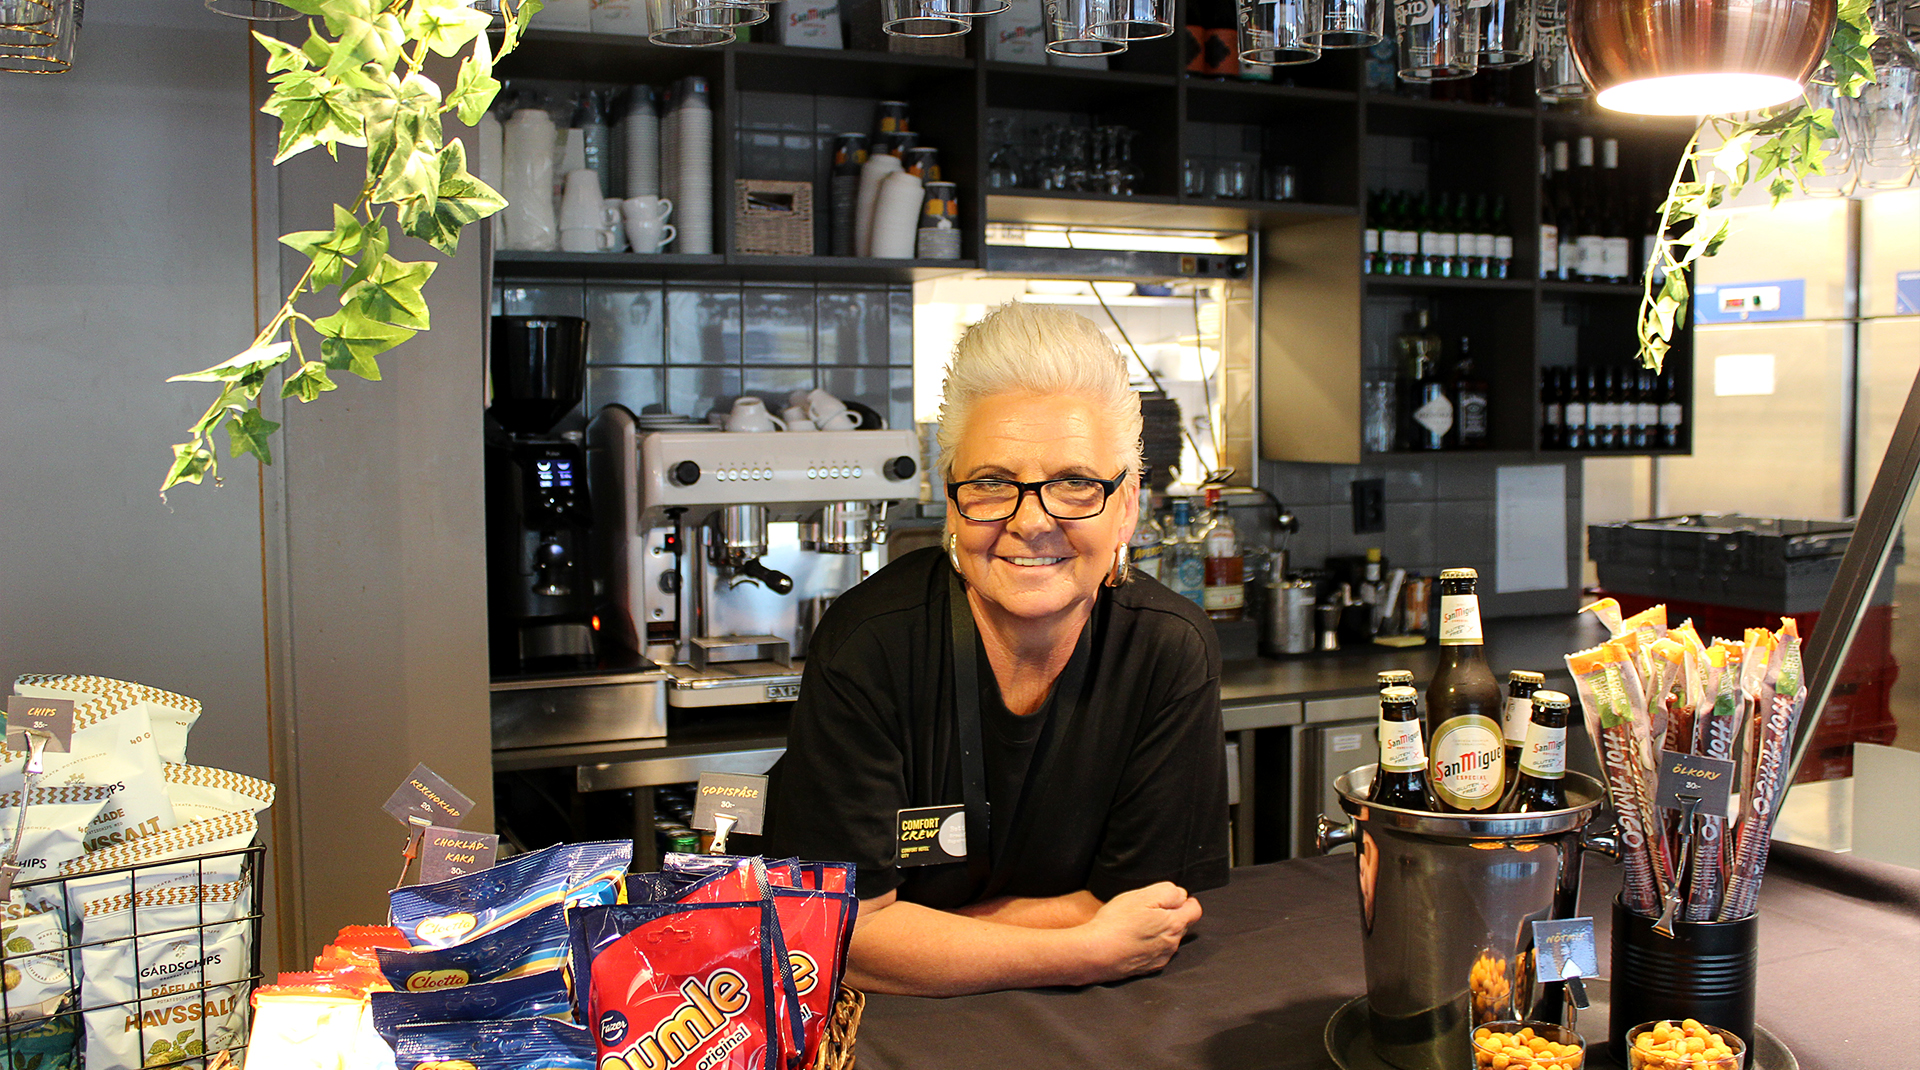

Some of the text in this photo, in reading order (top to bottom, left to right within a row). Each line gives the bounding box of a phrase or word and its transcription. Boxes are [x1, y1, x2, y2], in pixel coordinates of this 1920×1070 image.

[27, 707, 57, 717] CHIPS
[701, 785, 759, 799] GODISPÅSE
[1456, 782, 1479, 792] GLUTEN
[409, 778, 461, 817] KEXCHOKLAD
[1609, 775, 1645, 848] AMIGO
[901, 817, 940, 831] COMFORT
[82, 815, 161, 854] VSSALT
[901, 829, 940, 841] CREW
[433, 837, 490, 851] CHOKLAD-
[445, 852, 475, 864] KAKA
[424, 917, 471, 934] Cloetta
[411, 973, 465, 989] Cloetta
[124, 994, 236, 1032] HAVSSALT
[600, 1015, 628, 1034] Fazer
[697, 1025, 750, 1070] original
